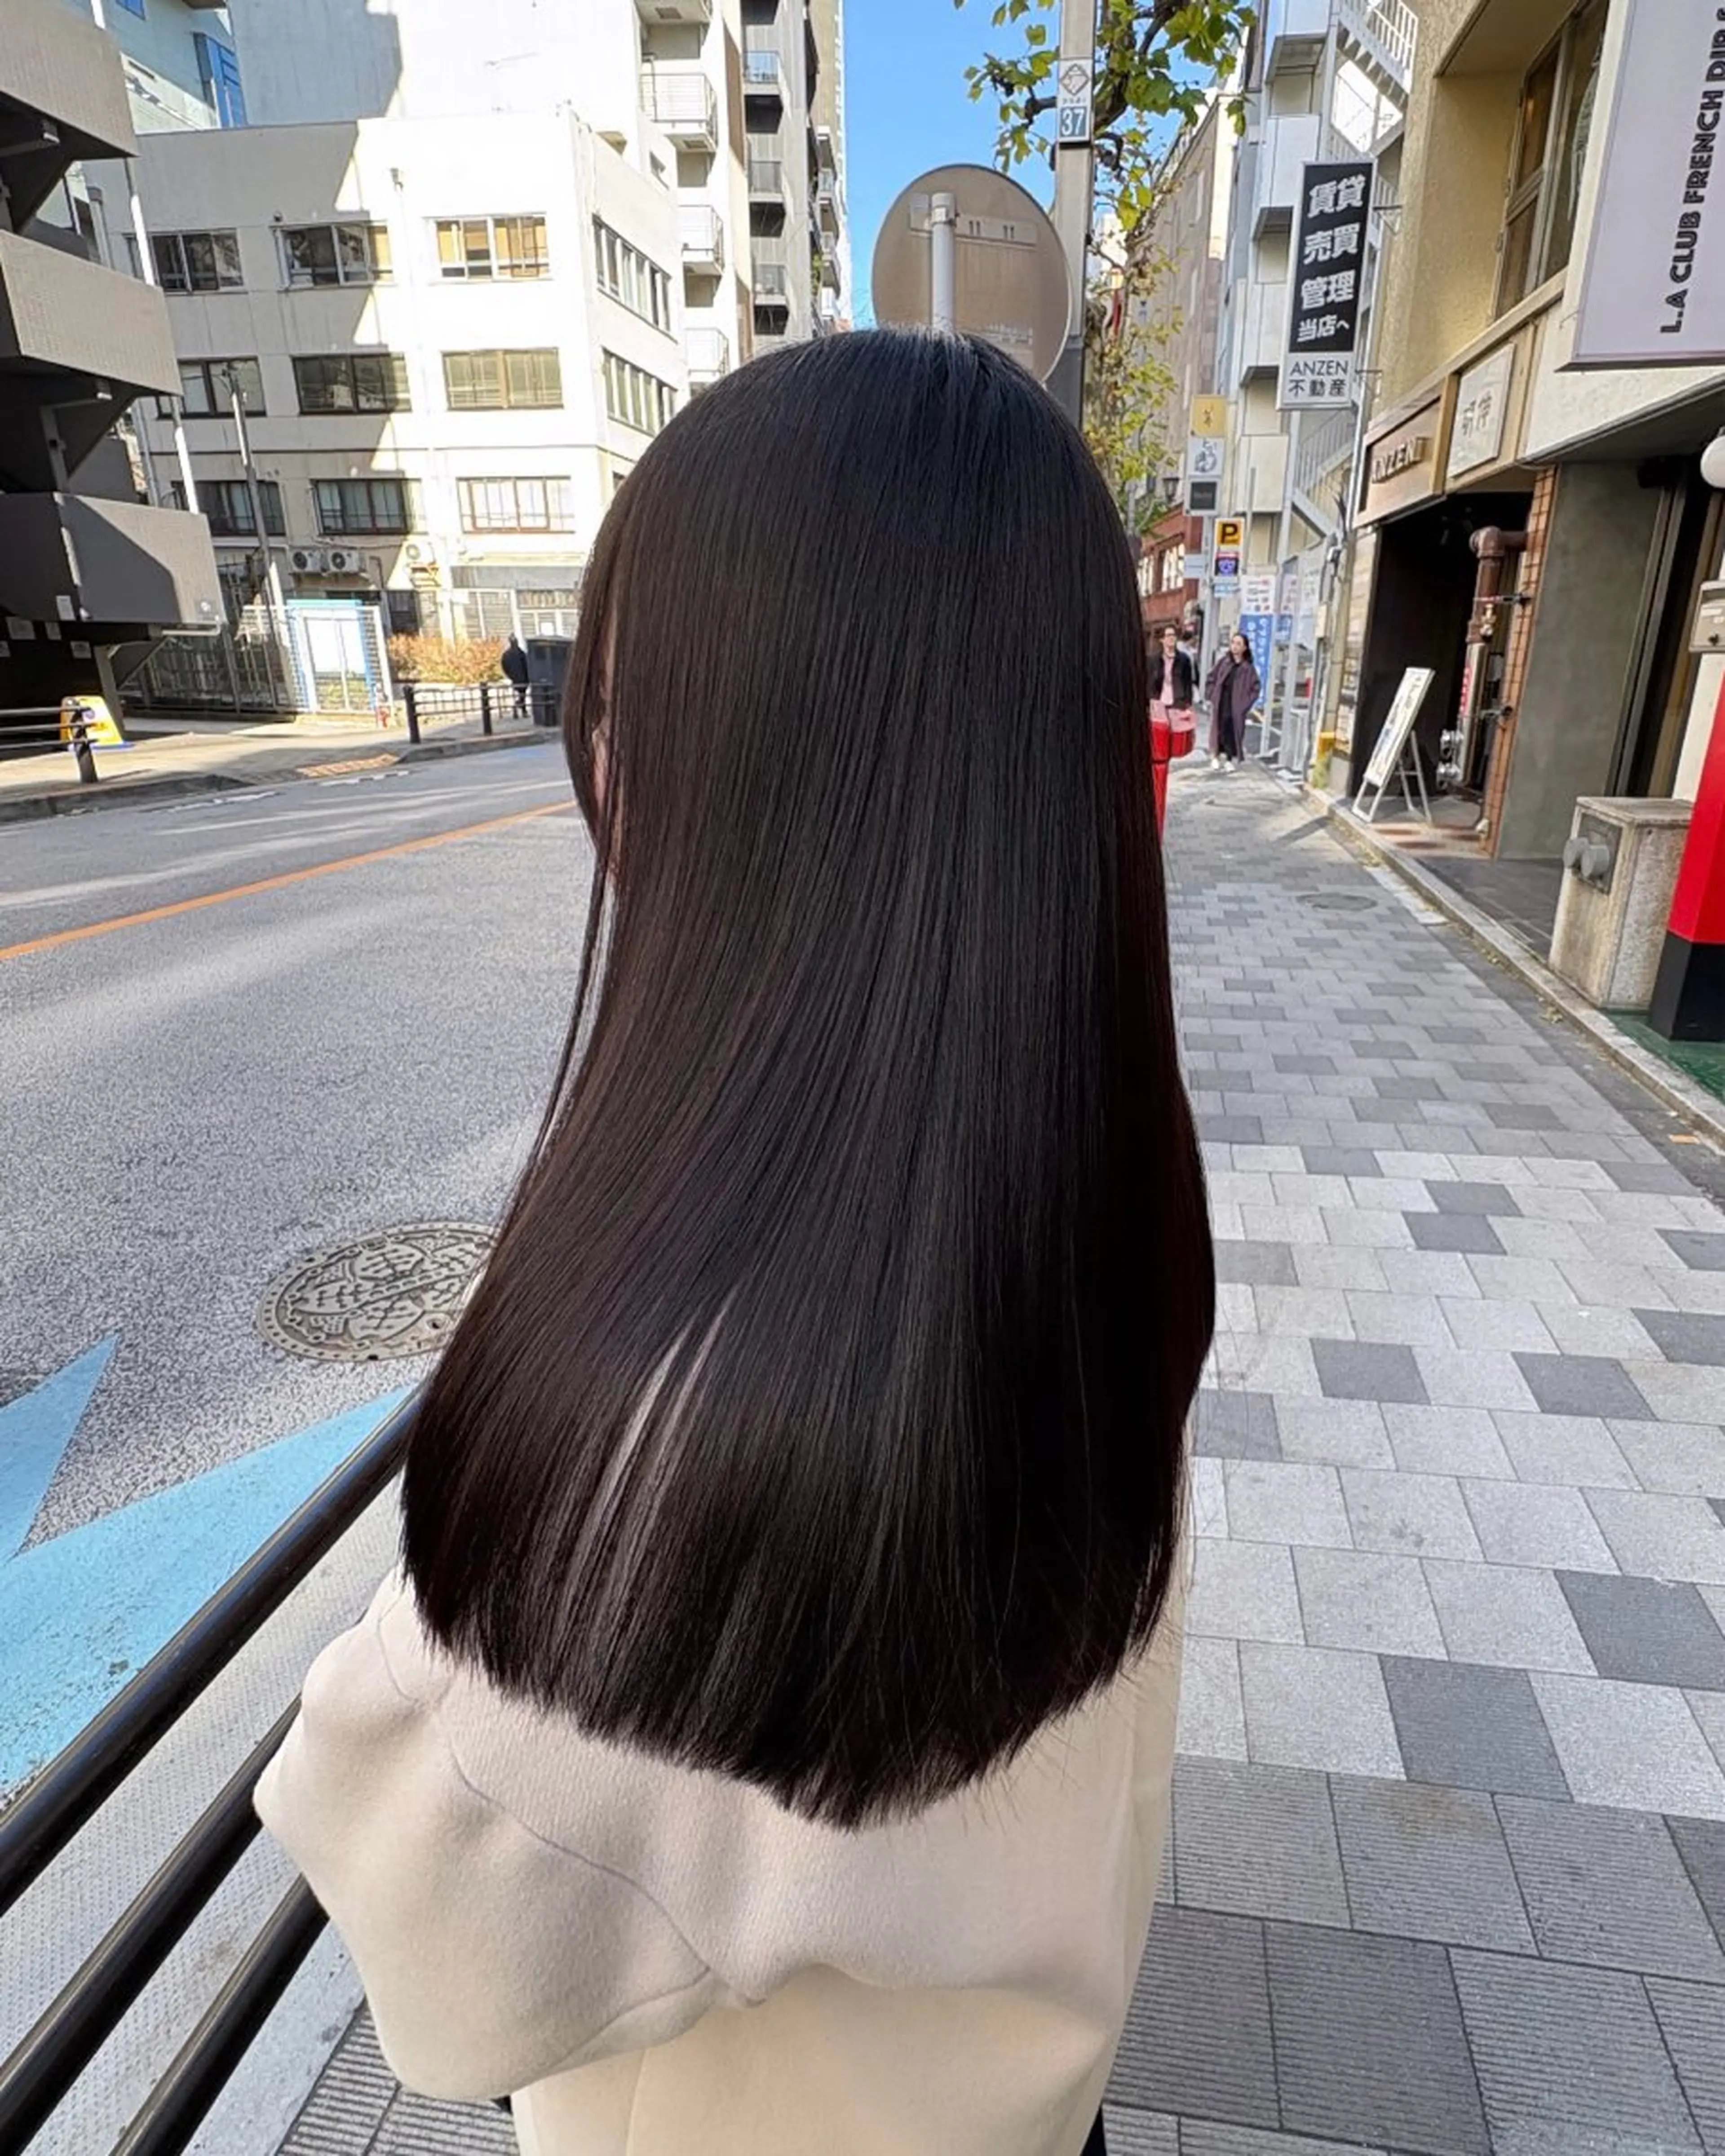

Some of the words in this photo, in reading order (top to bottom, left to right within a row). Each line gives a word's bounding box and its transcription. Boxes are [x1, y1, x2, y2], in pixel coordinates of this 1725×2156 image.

[1062, 108, 1085, 136] 37
[1683, 90, 1724, 204] FRENCH
[1307, 174, 1366, 218] 賃貸
[1303, 222, 1360, 265] 売買
[1669, 211, 1701, 283] CLUB
[1301, 269, 1356, 310] 管理
[1296, 314, 1350, 343] 当店へ
[1660, 288, 1688, 333] L.A
[1288, 379, 1346, 398] 不動産
[1290, 360, 1348, 376] ANZEN
[1220, 523, 1238, 544] P
